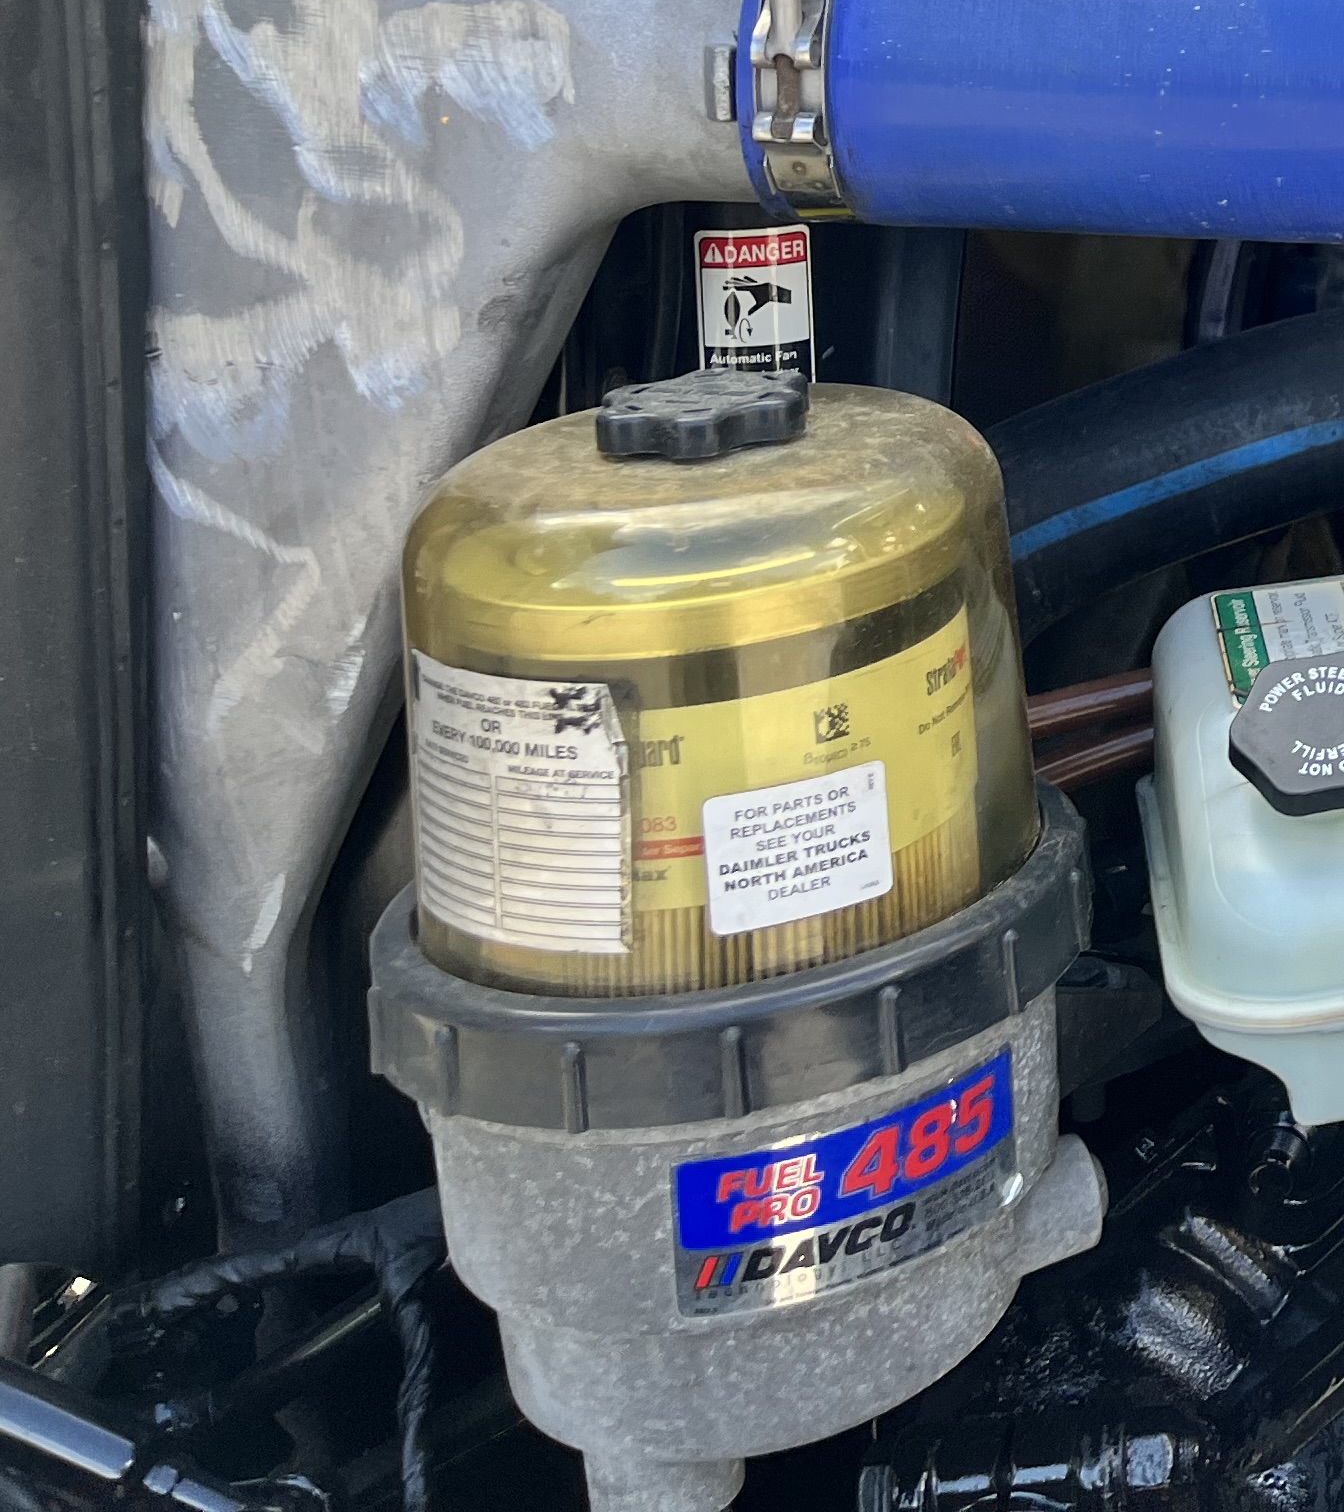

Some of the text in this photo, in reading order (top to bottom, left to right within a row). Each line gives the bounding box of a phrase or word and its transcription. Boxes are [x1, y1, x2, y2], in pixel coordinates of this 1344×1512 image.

[724, 240, 804, 263] DANGER
[710, 350, 798, 365] Automatic Fan
[1259, 671, 1306, 713] POWER
[481, 718, 502, 734] OR
[524, 743, 579, 761] MILES
[1299, 762, 1333, 776] NOT
[507, 765, 615, 780] MILEAGE AT SERVICE
[730, 801, 857, 840] REPLACEMENTS
[734, 786, 849, 822] FOR PARTS OR
[719, 830, 871, 876] DAIMLER TRUCKS
[756, 824, 835, 852] SEE YOUR
[724, 849, 869, 893] NORTH AMERICA
[768, 876, 831, 902] DEALER
[839, 1074, 996, 1202] 485
[716, 1153, 825, 1204] FUEL
[729, 1185, 821, 1235] PRO
[741, 1201, 913, 1282] DAVCO
